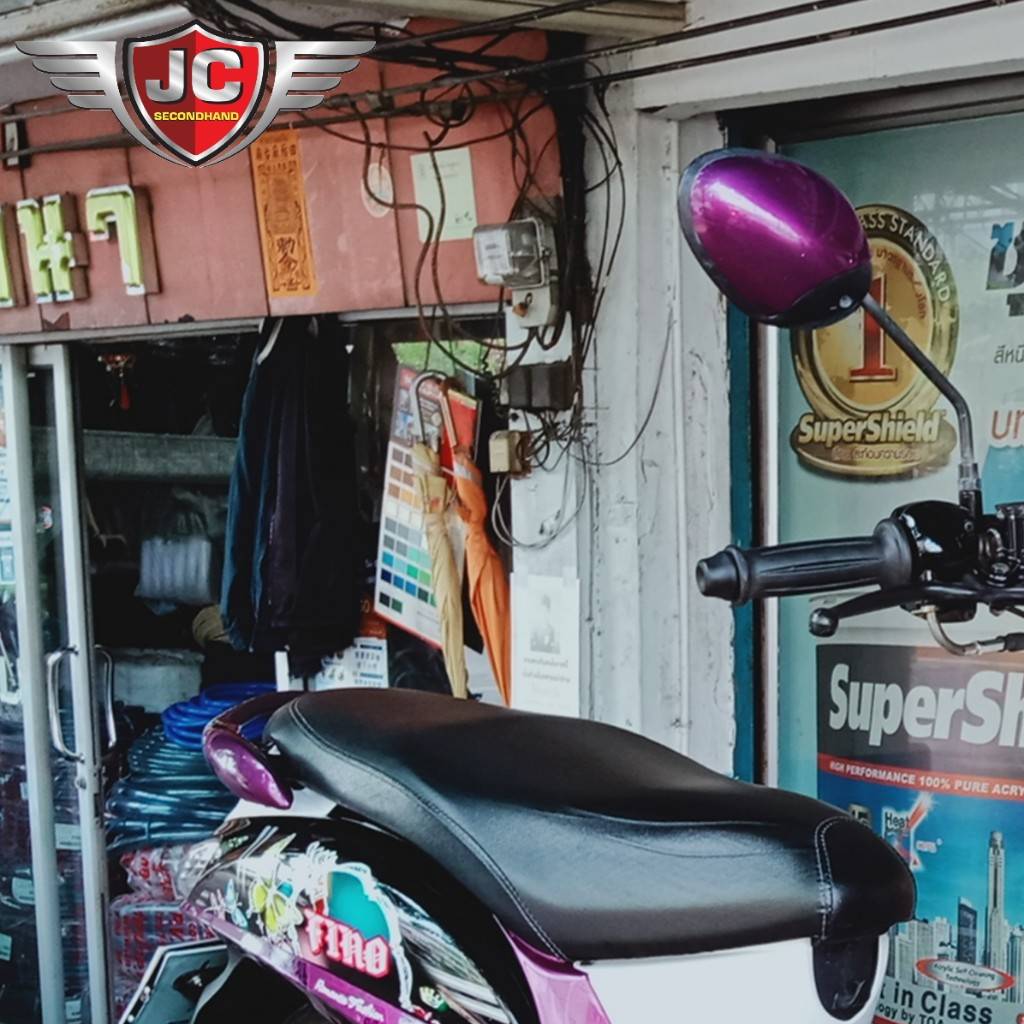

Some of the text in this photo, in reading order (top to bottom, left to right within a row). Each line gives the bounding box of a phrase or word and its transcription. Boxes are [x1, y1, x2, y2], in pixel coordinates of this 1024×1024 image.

[890, 213, 951, 303] STANDARD
[799, 411, 940, 447] SuperShield
[846, 764, 915, 785] PERFORMANCE
[919, 776, 951, 789] 100%
[954, 780, 989, 793] PURE
[894, 981, 914, 1008] in
[921, 990, 993, 1024] Class
